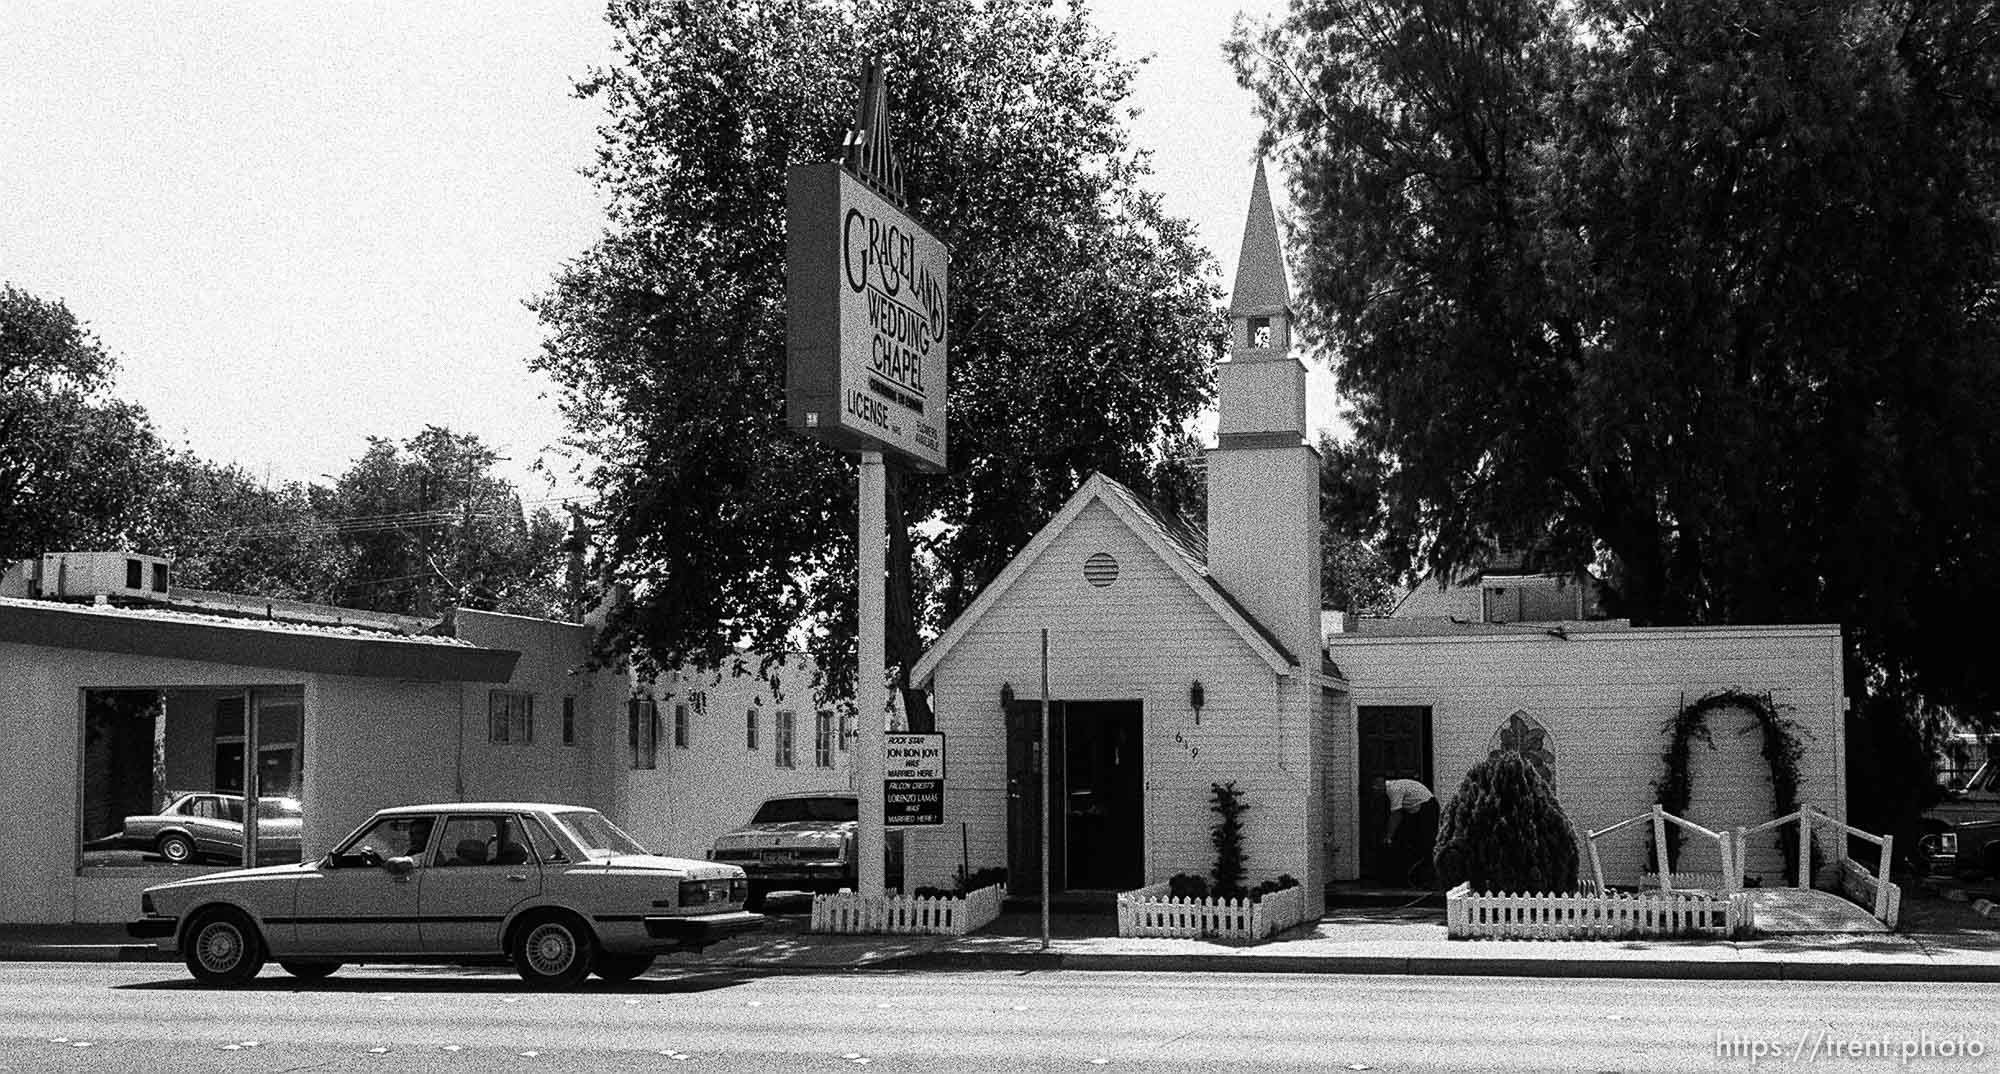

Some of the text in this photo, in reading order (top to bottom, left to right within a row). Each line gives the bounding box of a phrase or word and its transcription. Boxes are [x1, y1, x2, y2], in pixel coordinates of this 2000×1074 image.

[844, 207, 945, 343] GRACELAND
[867, 287, 930, 355] WEDDING
[873, 333, 924, 392] CHAPEL
[847, 388, 889, 430] LICENSE
[888, 736, 925, 745] ROCK STAR
[1175, 731, 1199, 759] 619
[886, 748, 938, 759] JON BON JOVI
[905, 759, 920, 767] WAS
[887, 769, 915, 777] MARRIED
[887, 792, 938, 803] LORENZO LAMAS
[887, 815, 915, 823] MARRIED
